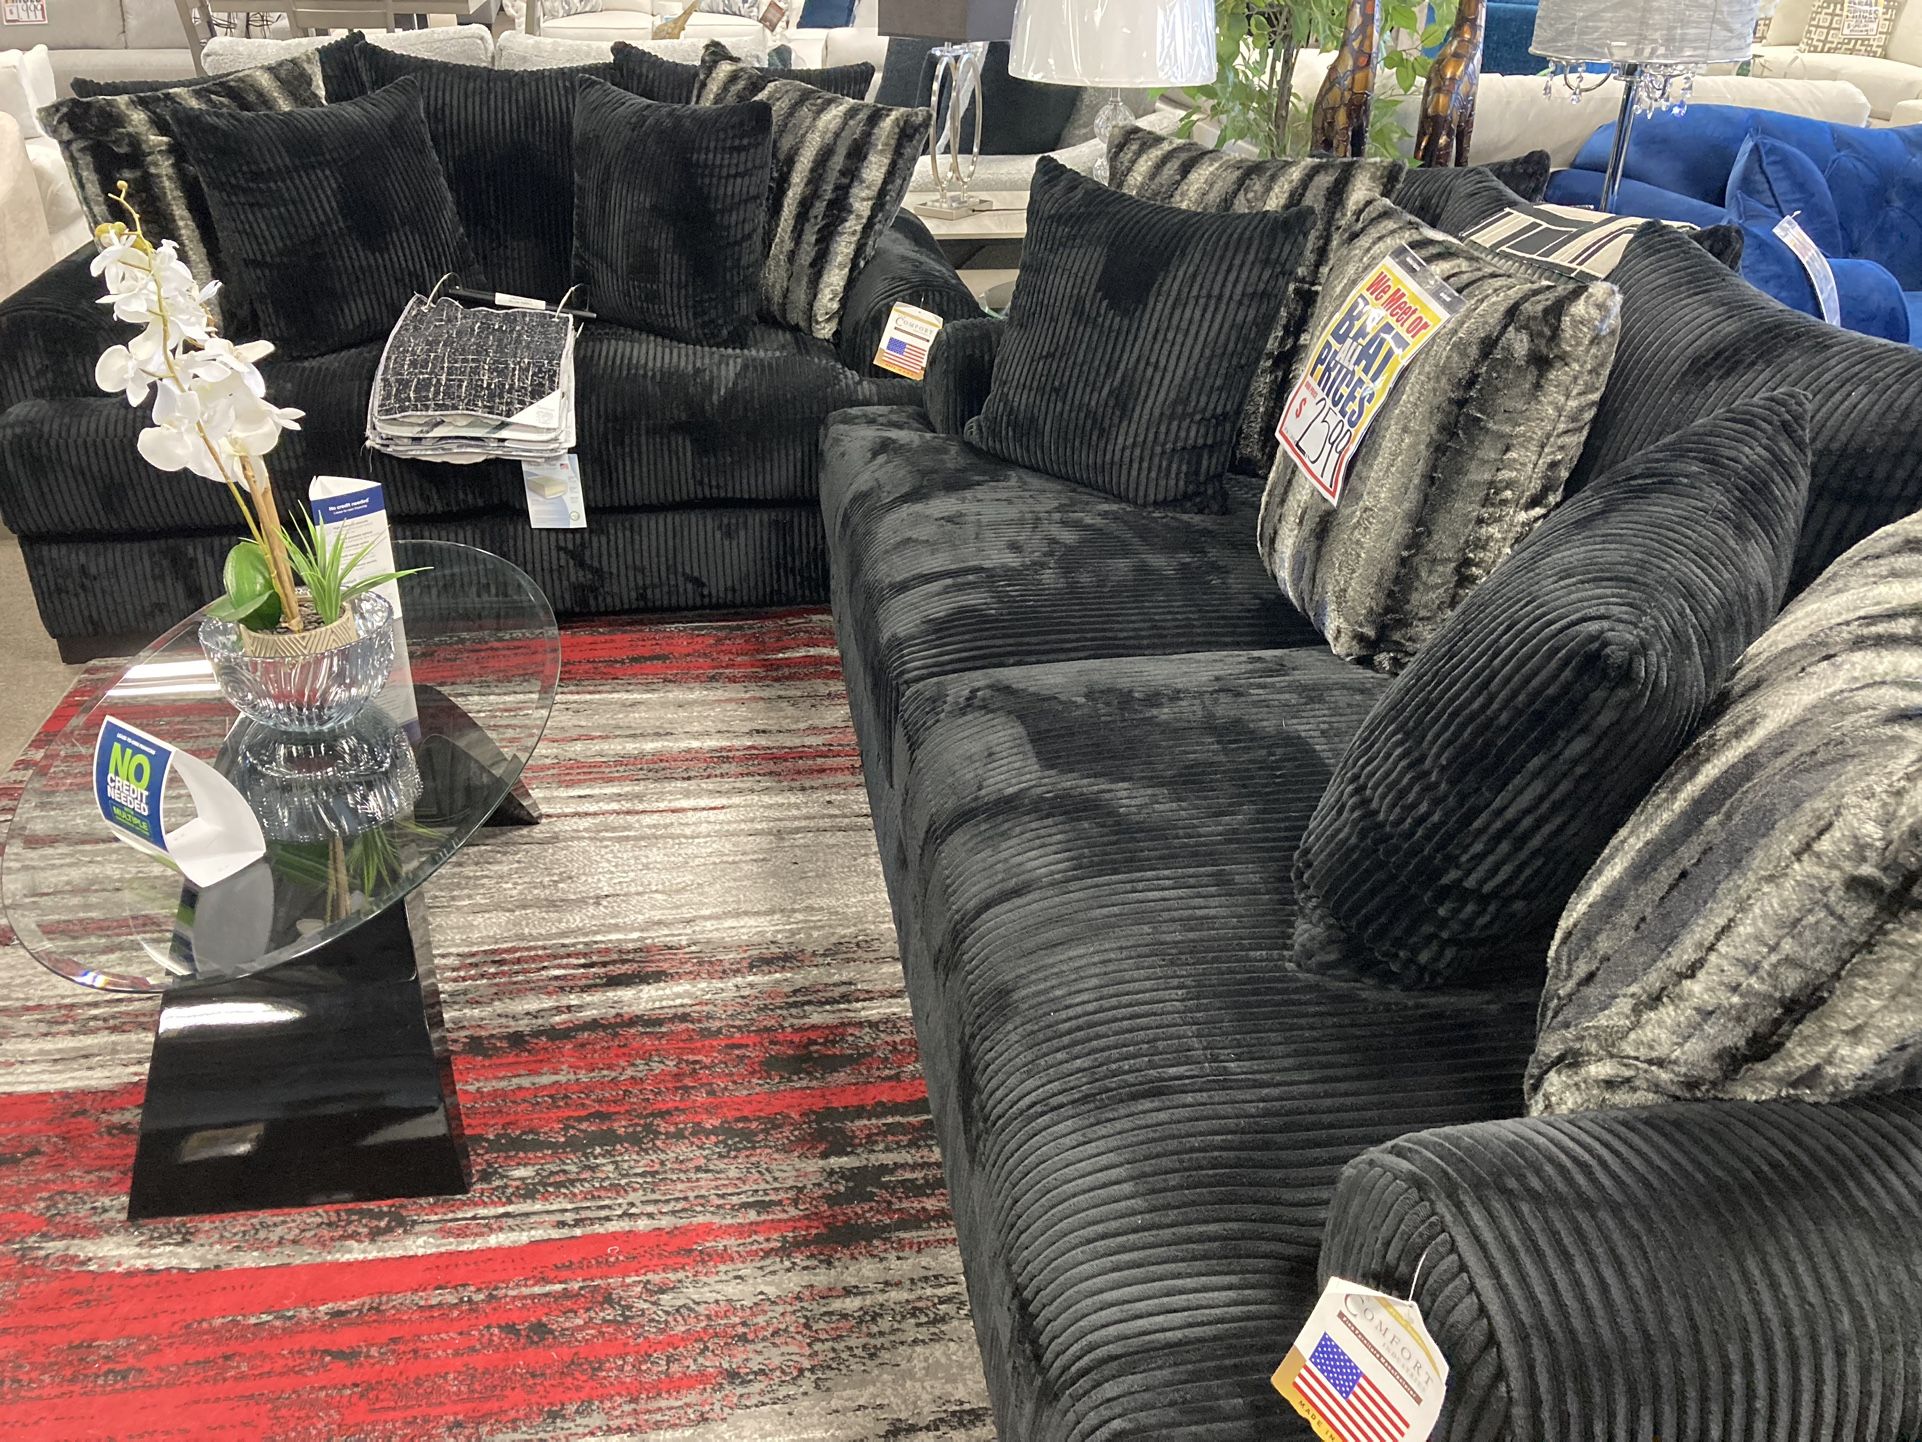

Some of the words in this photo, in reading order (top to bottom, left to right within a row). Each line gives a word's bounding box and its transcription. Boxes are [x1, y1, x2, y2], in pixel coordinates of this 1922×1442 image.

[1366, 271, 1386, 301] We
[1382, 287, 1416, 328] Meet
[1406, 316, 1430, 339] or
[1309, 339, 1376, 429] PRICES
[1295, 397, 1307, 419] $
[1296, 397, 1352, 489] 2599
[107, 773, 149, 803] CREDIT
[108, 742, 151, 789] NO
[107, 785, 149, 816] NEEDED
[1344, 1294, 1434, 1385] COMFORT
[1299, 1401, 1323, 1428] MADE
